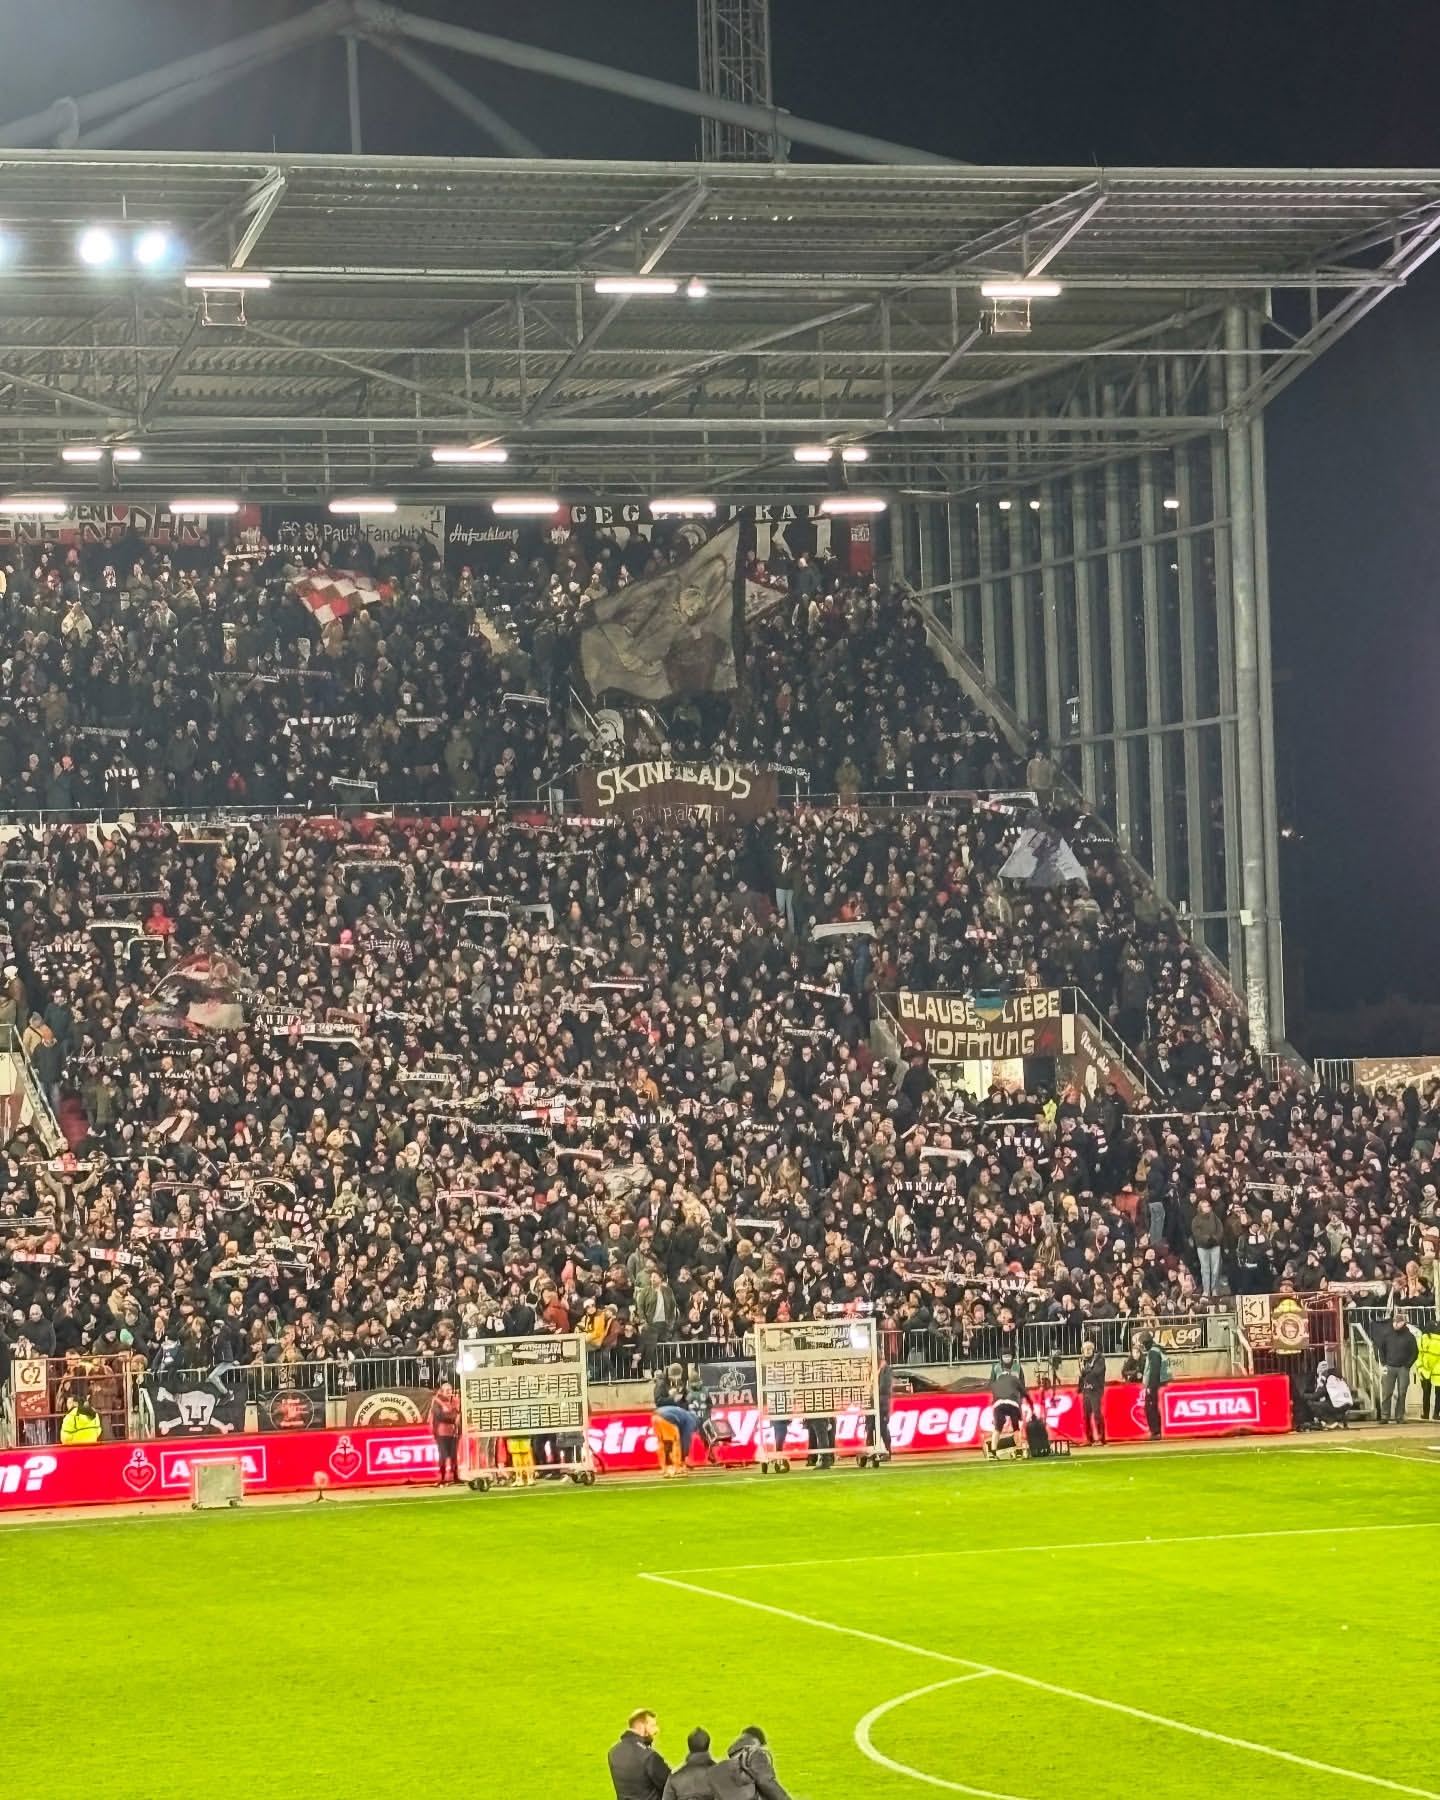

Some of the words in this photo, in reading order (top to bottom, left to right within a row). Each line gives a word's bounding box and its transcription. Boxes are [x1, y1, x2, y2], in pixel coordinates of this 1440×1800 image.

[596, 761, 751, 806] SKINHEADS
[899, 991, 979, 1025] GLAUBE
[1001, 989, 1061, 1024] LIEBE
[924, 1028, 1035, 1057] HOFFNUNG
[20, 1366, 41, 1385] C2
[1173, 1397, 1252, 1418] ASTRA
[375, 1443, 439, 1465] ASTR
